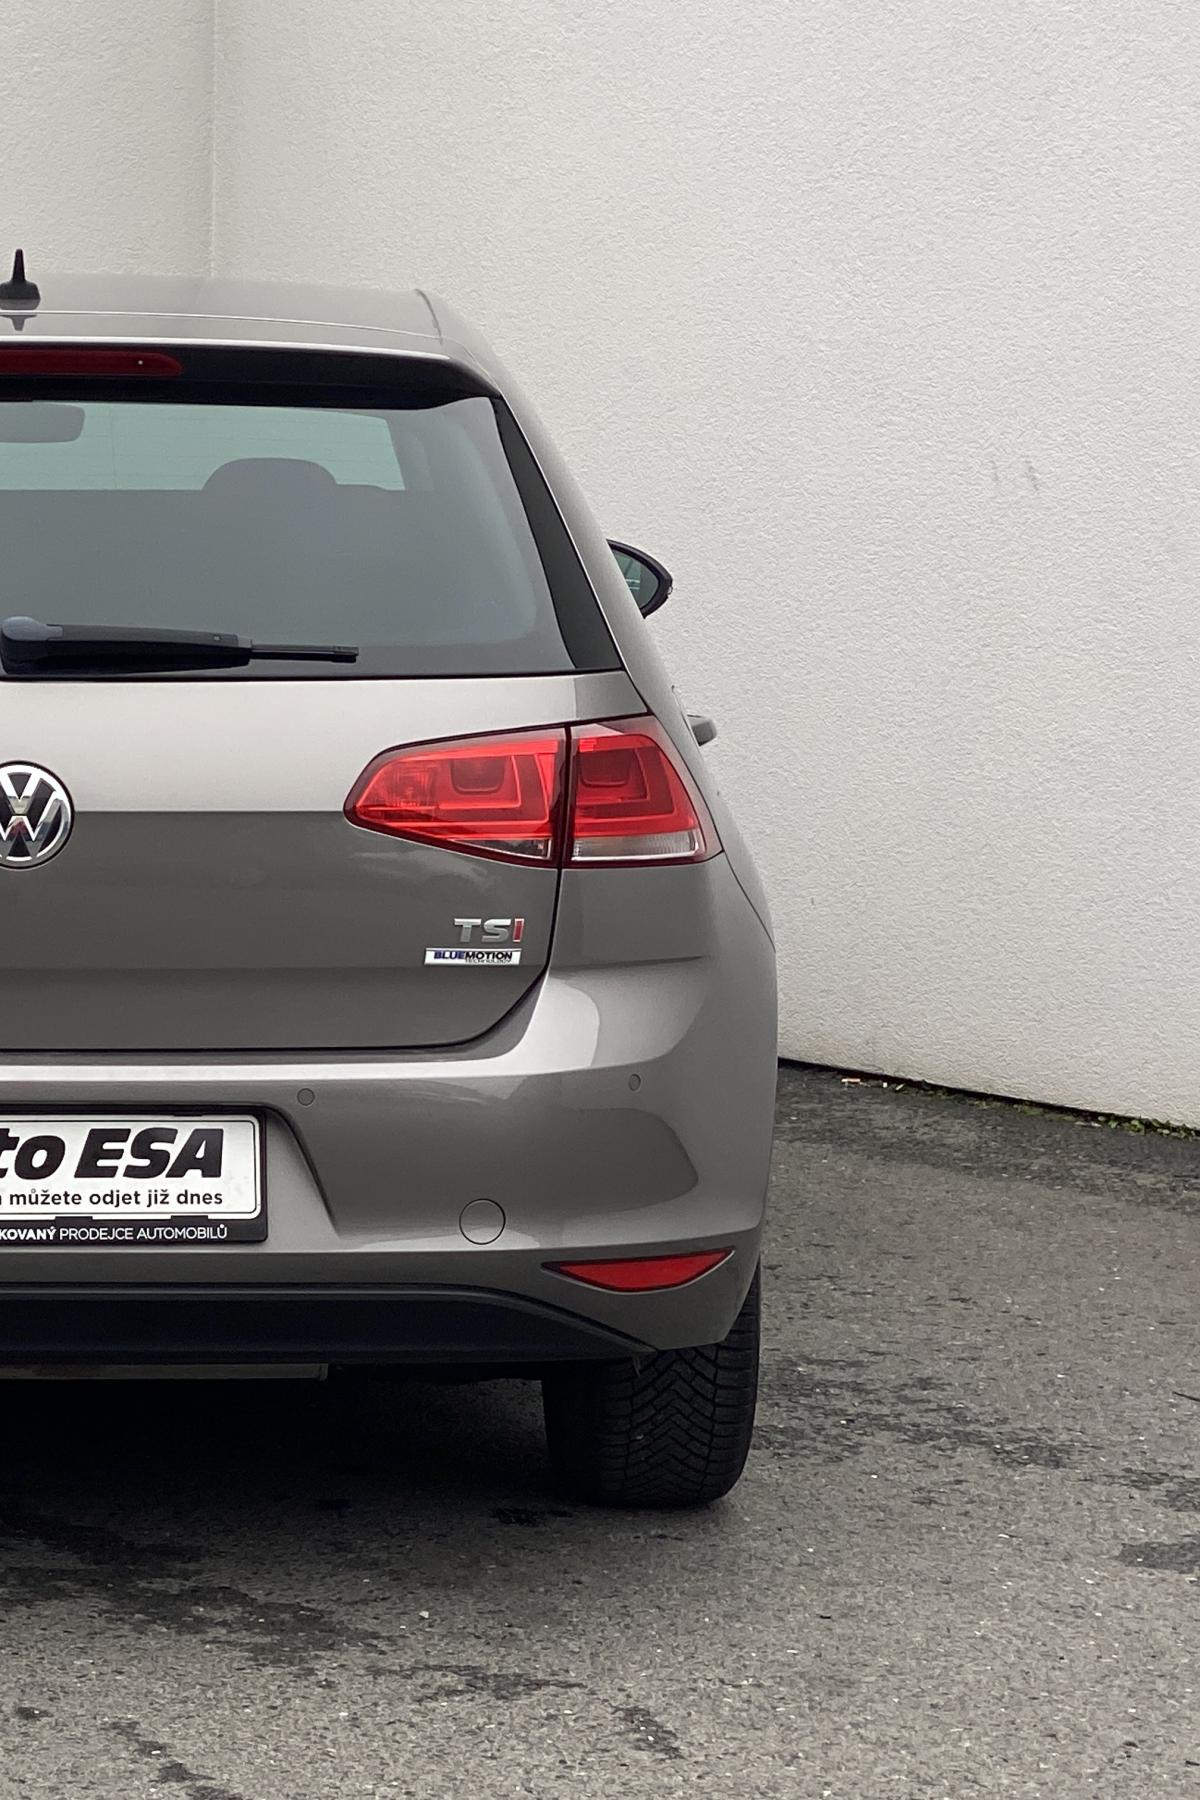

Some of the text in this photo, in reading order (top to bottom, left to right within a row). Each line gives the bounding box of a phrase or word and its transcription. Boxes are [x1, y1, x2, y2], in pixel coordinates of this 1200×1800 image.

[434, 951, 513, 960] BLUEMOTION
[74, 1127, 224, 1179] ESA
[9, 1188, 82, 1205] můžete
[89, 1190, 141, 1207] odjet
[146, 1189, 170, 1207] již
[176, 1189, 223, 1205] dnes
[60, 1227, 134, 1240] PRODEJCE
[137, 1224, 228, 1240] AUTOMOBILŮ
